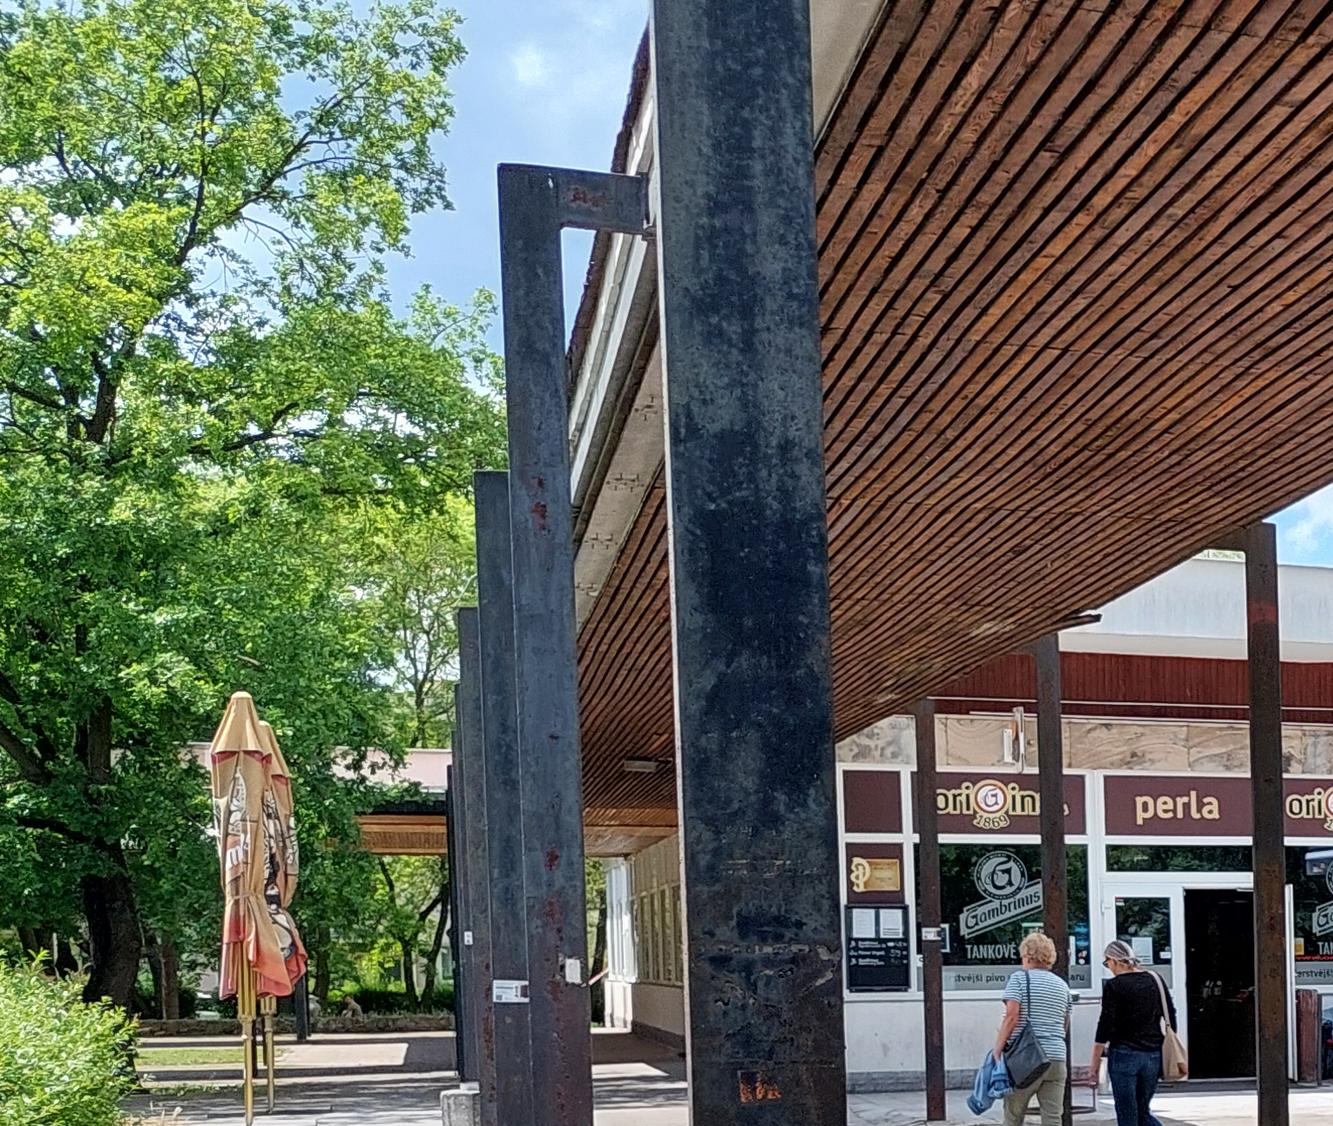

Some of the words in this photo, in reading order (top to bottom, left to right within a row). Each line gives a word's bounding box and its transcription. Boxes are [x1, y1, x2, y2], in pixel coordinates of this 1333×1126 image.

[1135, 790, 1220, 825] perla
[973, 813, 1010, 830] 1869
[964, 889, 1041, 930] Gambrinus
[966, 941, 1018, 960] TANKOVÉ
